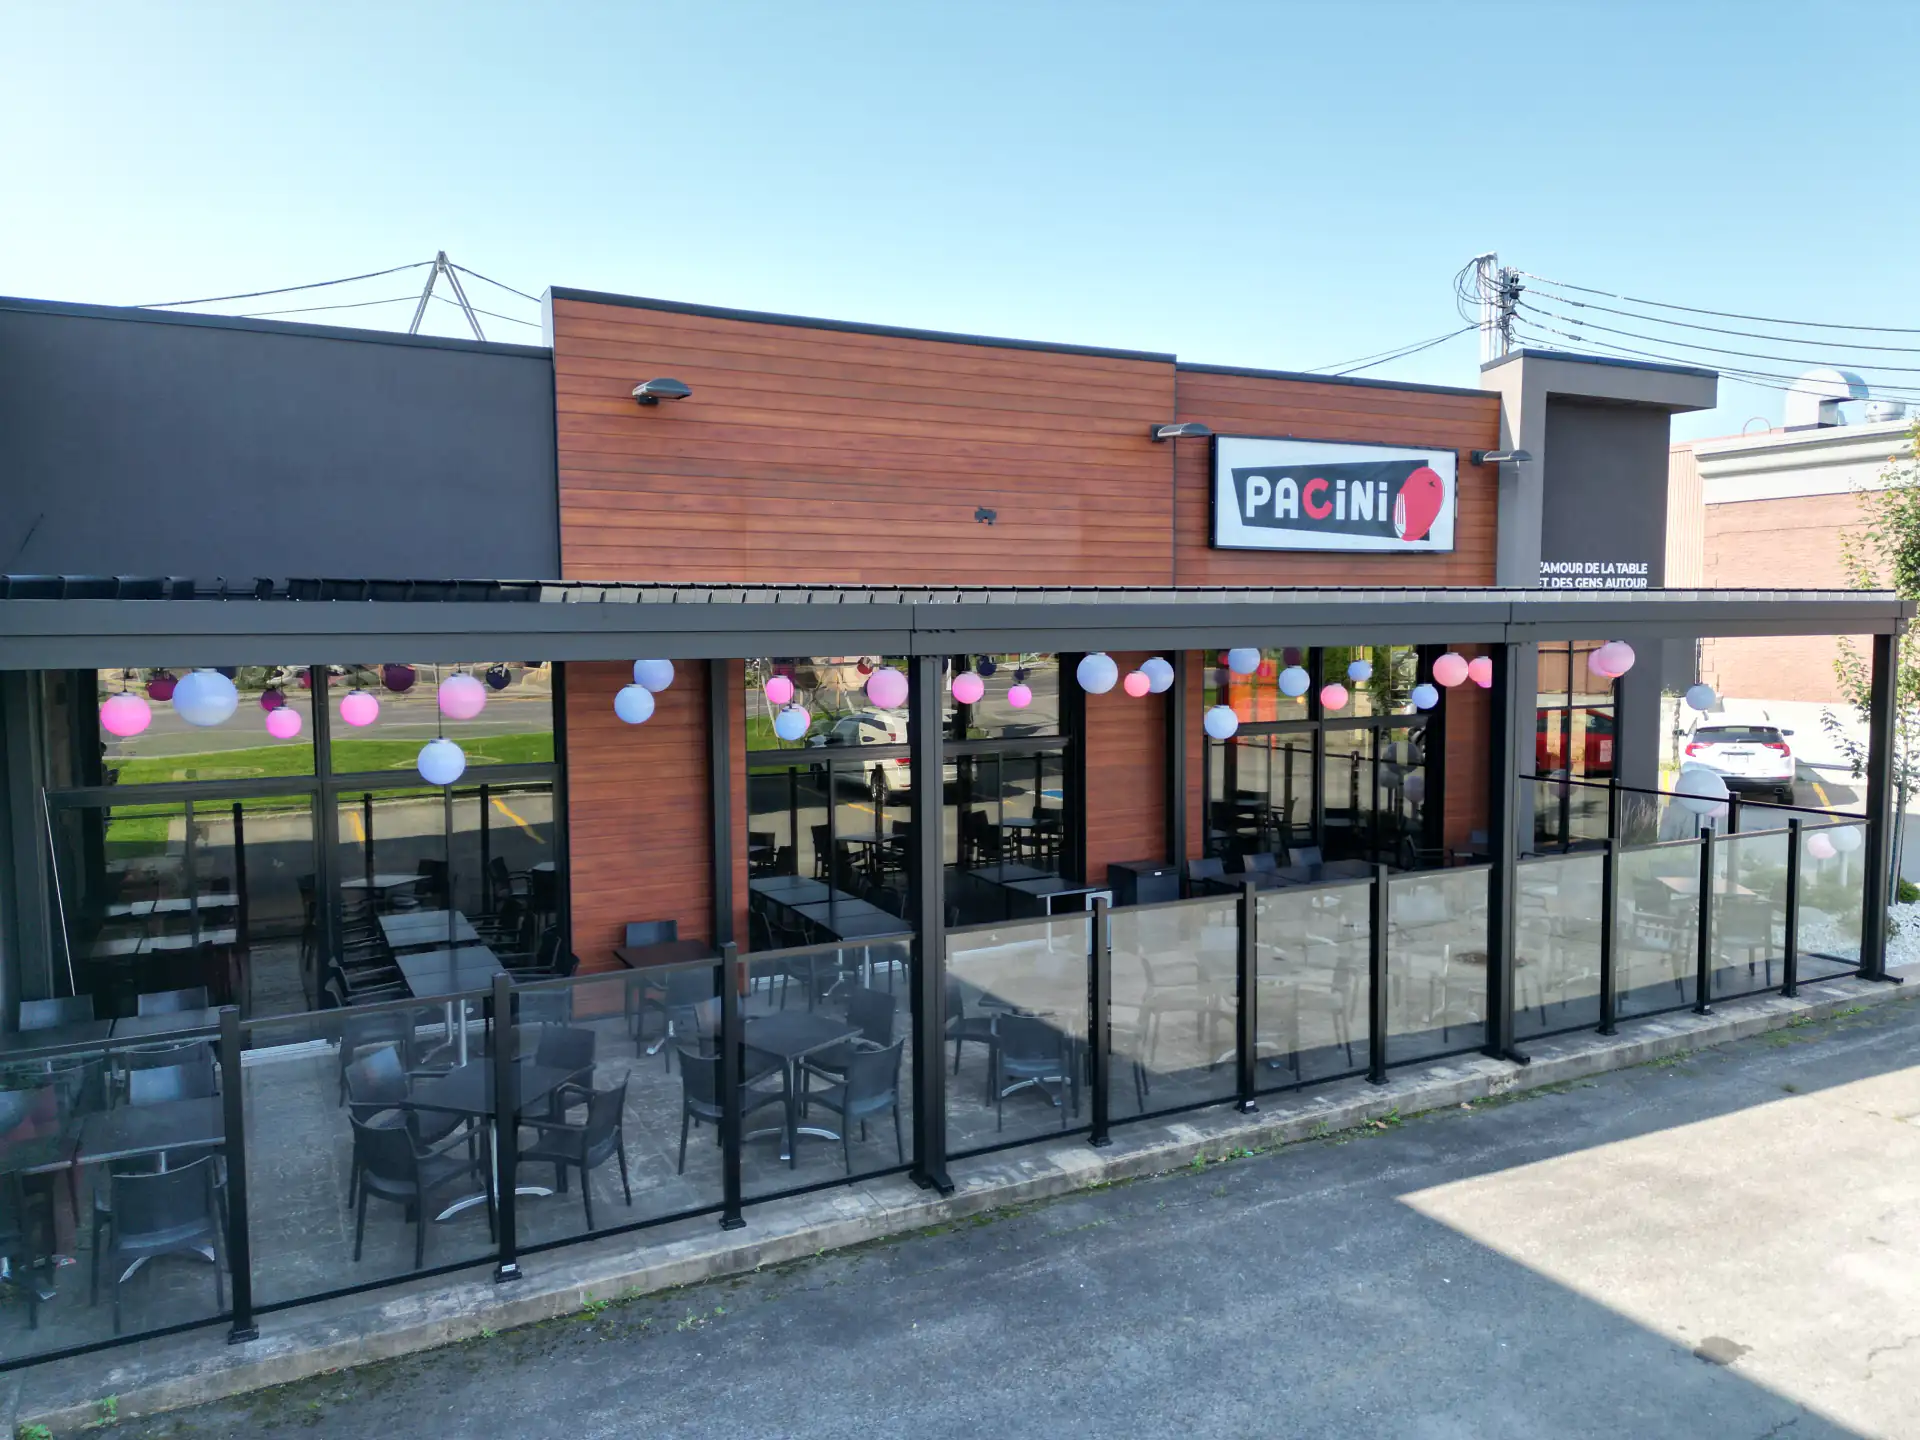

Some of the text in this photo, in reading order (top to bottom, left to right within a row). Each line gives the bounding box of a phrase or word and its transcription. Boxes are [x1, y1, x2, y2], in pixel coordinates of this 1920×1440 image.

[1540, 561, 1648, 574] 'AMOUR DE LA TABLE
[1551, 577, 1573, 588] DES
[1575, 577, 1603, 588] GENS
[1605, 577, 1648, 588] AUTOUR
